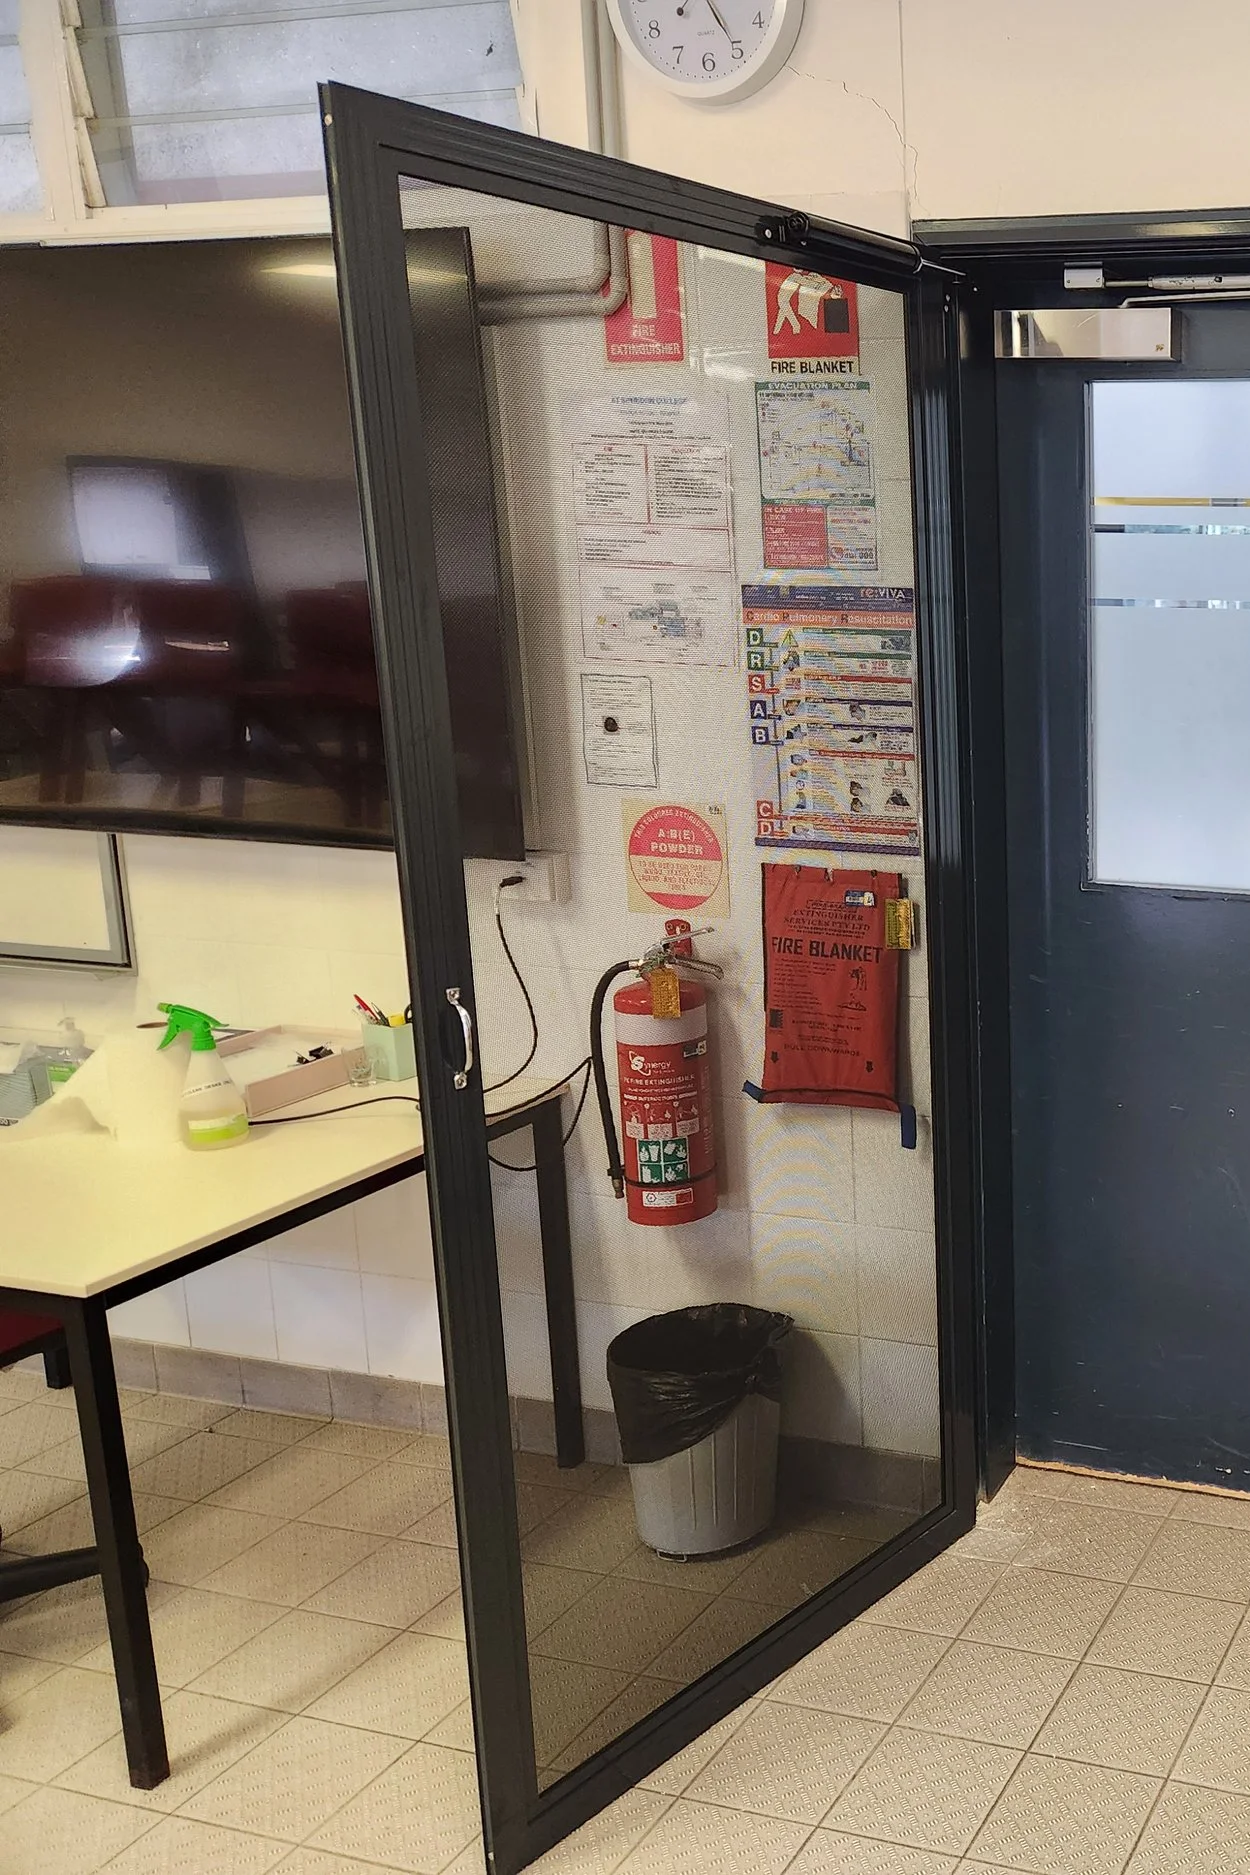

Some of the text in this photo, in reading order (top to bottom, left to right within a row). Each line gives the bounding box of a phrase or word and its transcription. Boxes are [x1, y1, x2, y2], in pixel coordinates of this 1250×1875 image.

[752, 11, 765, 29] 4
[648, 20, 661, 39] 8
[672, 46, 684, 64] 7
[731, 40, 744, 60] 5
[702, 52, 716, 72] 6
[771, 360, 854, 374] FIRE BLANKET
[782, 612, 838, 625] Pulmonary
[840, 613, 913, 625] Resuscitation
[750, 630, 760, 645] D
[751, 652, 762, 668] R
[751, 677, 762, 692] S
[753, 703, 764, 718] A
[755, 728, 767, 743] B
[759, 802, 771, 817] C
[761, 823, 772, 835] D
[650, 842, 703, 855] POWDER
[771, 937, 884, 963] FIRE BLANKET
